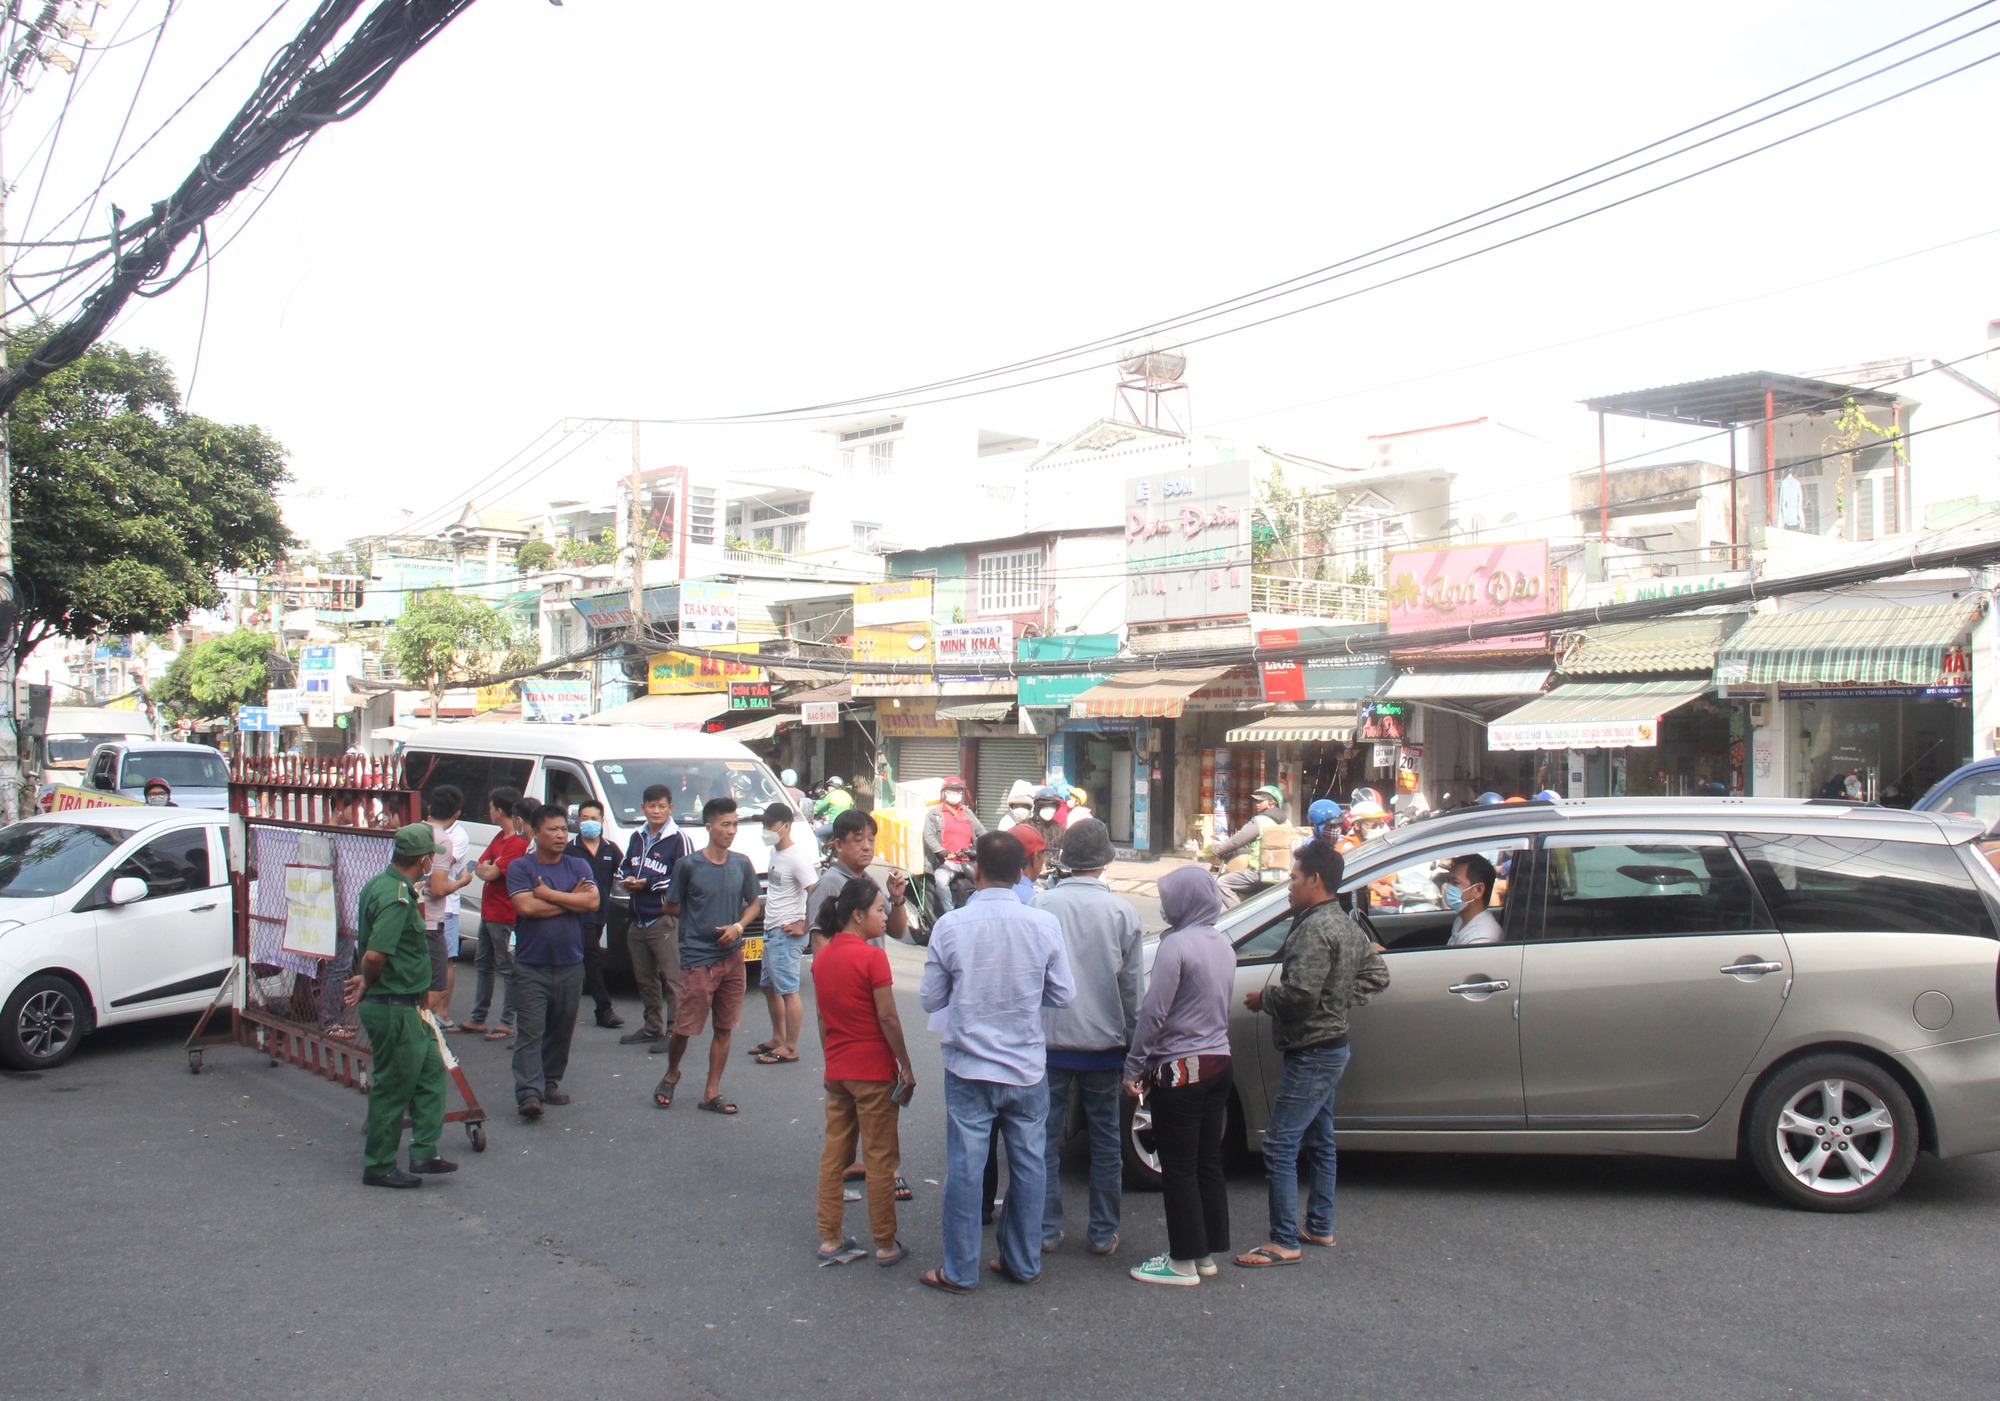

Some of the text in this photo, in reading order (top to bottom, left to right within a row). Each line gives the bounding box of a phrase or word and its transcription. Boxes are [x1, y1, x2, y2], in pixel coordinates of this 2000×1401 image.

[940, 638, 967, 652] MINH
[971, 636, 1002, 651] KHAI
[526, 690, 555, 702] TRẦN
[558, 690, 587, 702] DŨNG
[751, 682, 769, 696] TẤM
[733, 696, 768, 708] BÀ HAI
[59, 792, 83, 812] TRÀ
